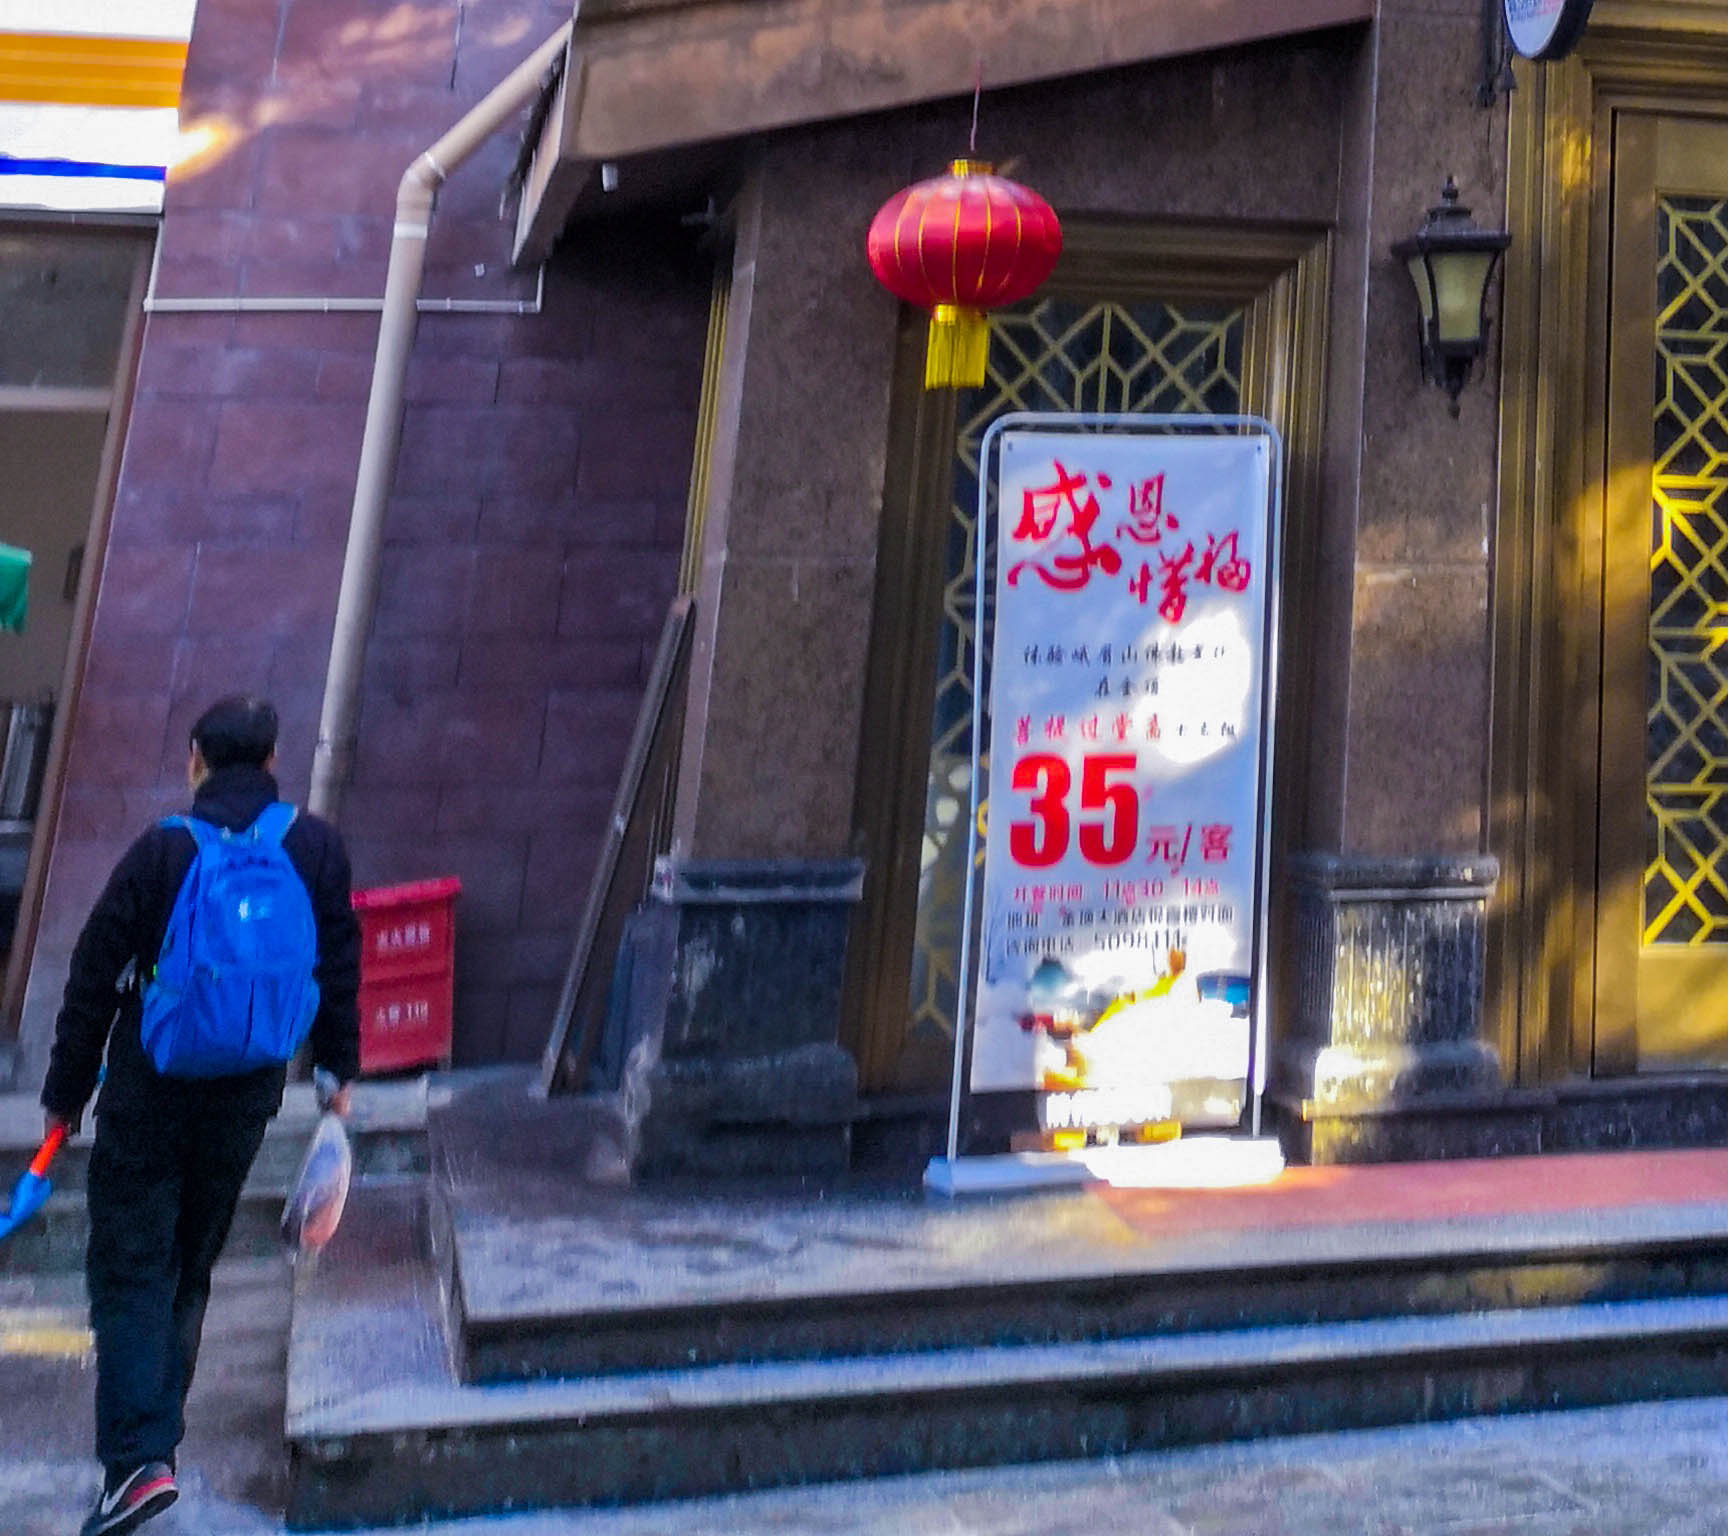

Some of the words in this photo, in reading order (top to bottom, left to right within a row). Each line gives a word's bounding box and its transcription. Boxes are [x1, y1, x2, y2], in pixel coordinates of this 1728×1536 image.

[1007, 458, 1179, 591] 感恩
[1128, 531, 1252, 624] 惜福
[1010, 752, 1140, 870] 35
[1147, 823, 1233, 865] 元/客
